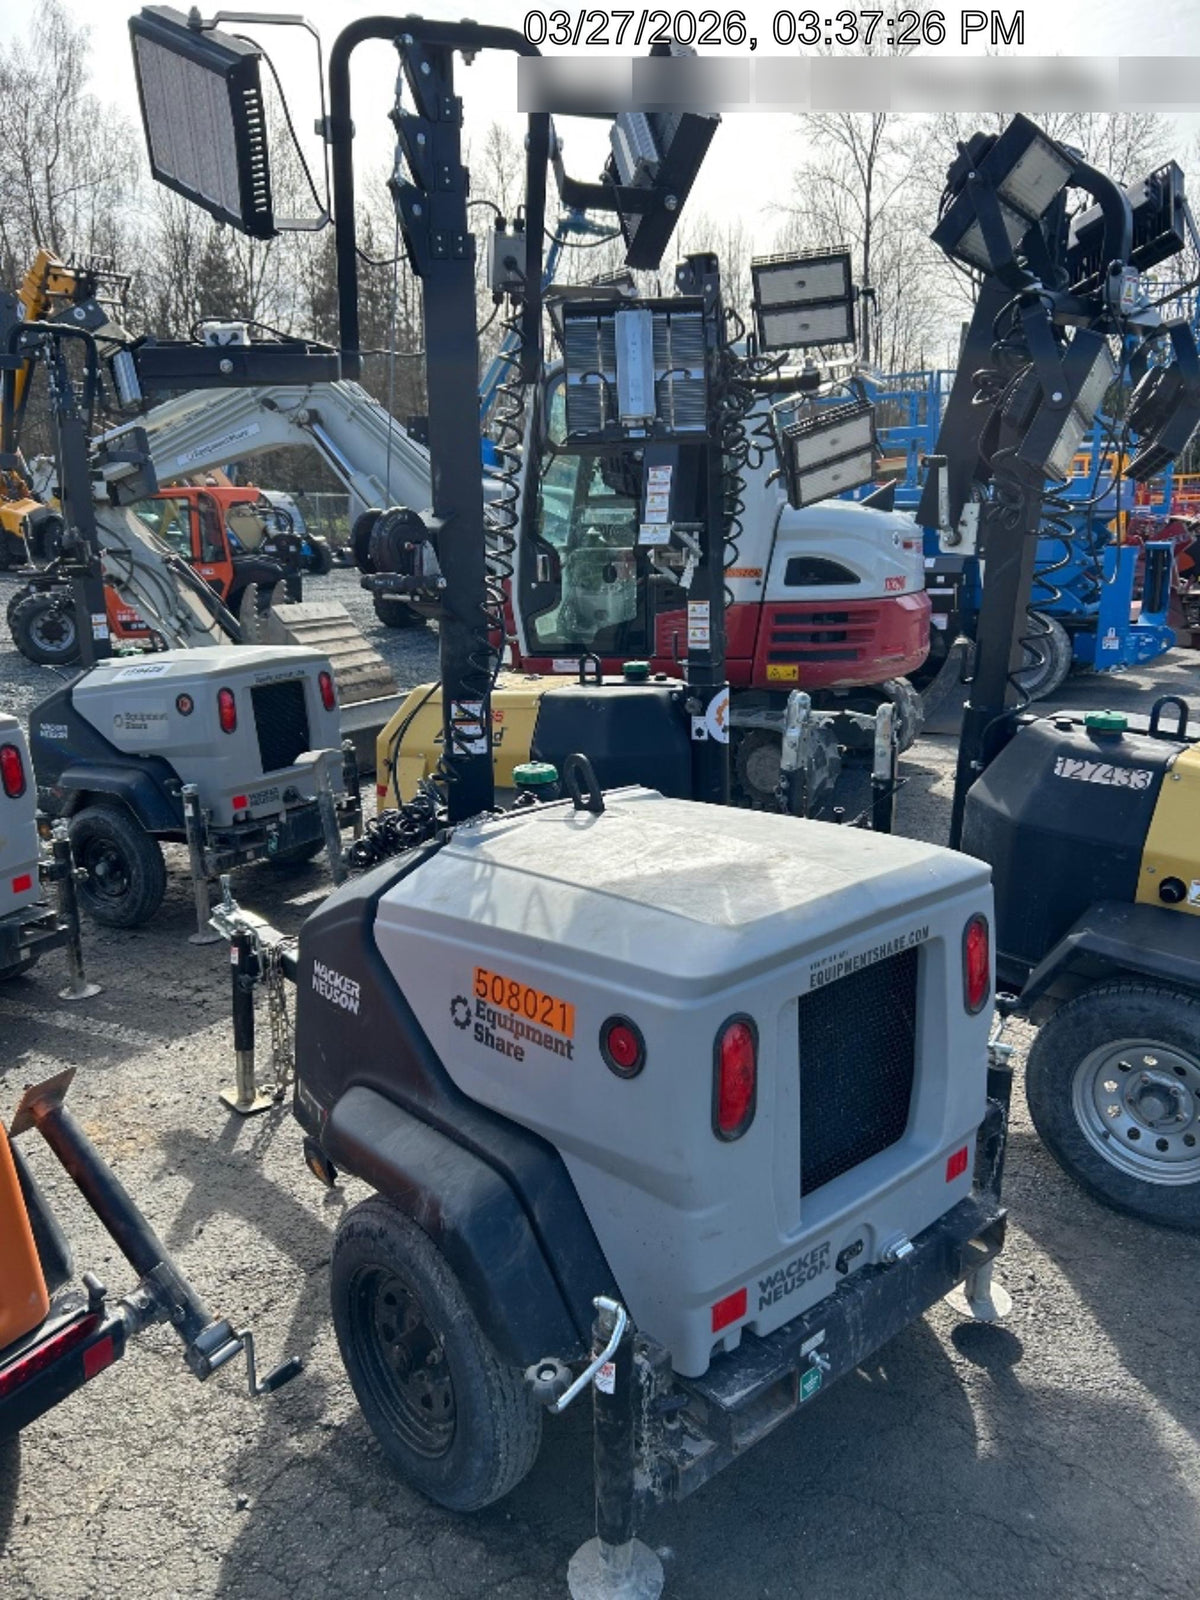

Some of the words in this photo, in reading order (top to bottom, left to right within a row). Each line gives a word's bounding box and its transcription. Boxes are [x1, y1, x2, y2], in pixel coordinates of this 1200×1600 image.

[313, 959, 361, 997] WACKER
[809, 925, 929, 989] EQUIPMENTSHARE.COM
[312, 973, 361, 1016] NEUSON
[475, 967, 568, 1033] 508021
[473, 1022, 526, 1062] Share
[474, 997, 575, 1061] Equipment
[758, 1241, 831, 1294] WACKER
[758, 1260, 831, 1312] NEUSON
